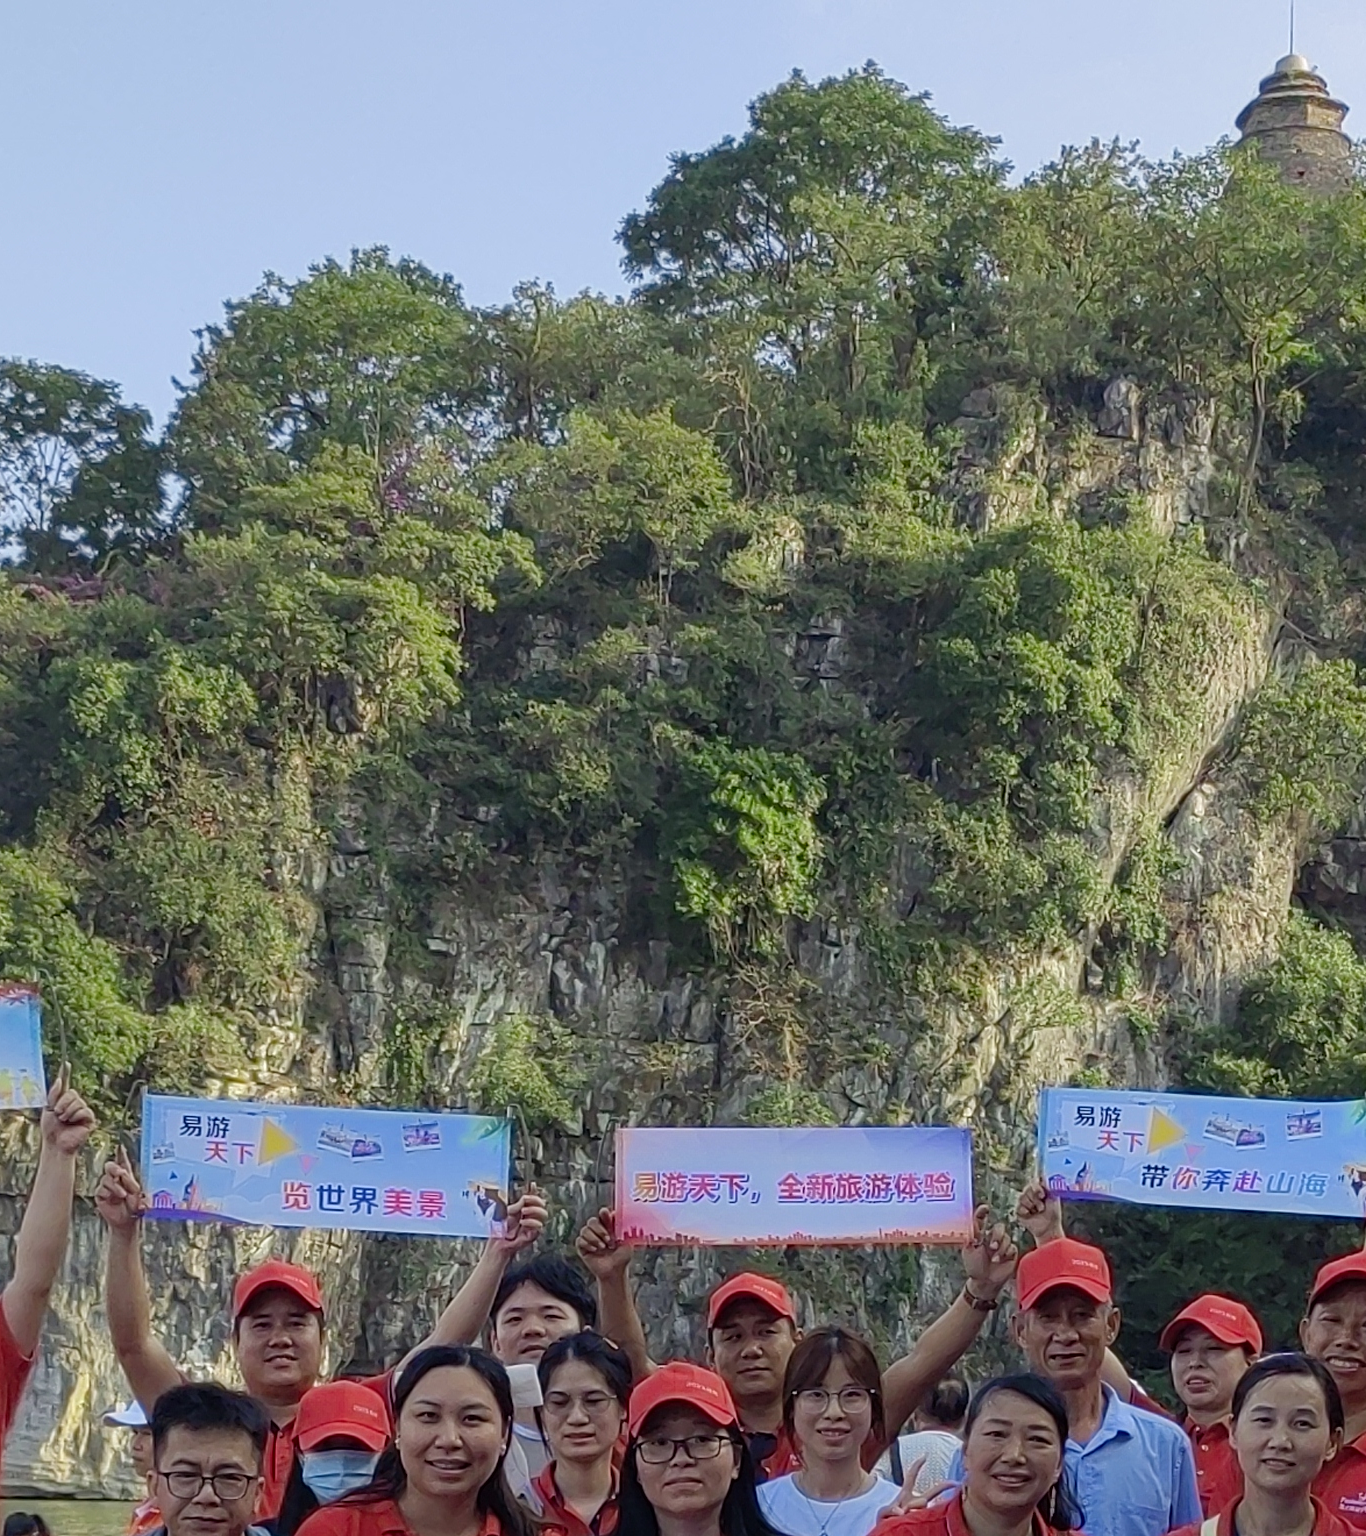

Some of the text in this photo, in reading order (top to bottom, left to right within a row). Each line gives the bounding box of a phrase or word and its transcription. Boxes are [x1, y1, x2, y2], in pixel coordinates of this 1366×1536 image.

[178, 1114, 231, 1139] 易游
[1073, 1105, 1123, 1129] 易游
[204, 1140, 256, 1165] 天下
[1096, 1129, 1146, 1153] 天下
[1140, 1163, 1331, 1198] 带你奔赴山海
[281, 1180, 448, 1219] 览世界美景
